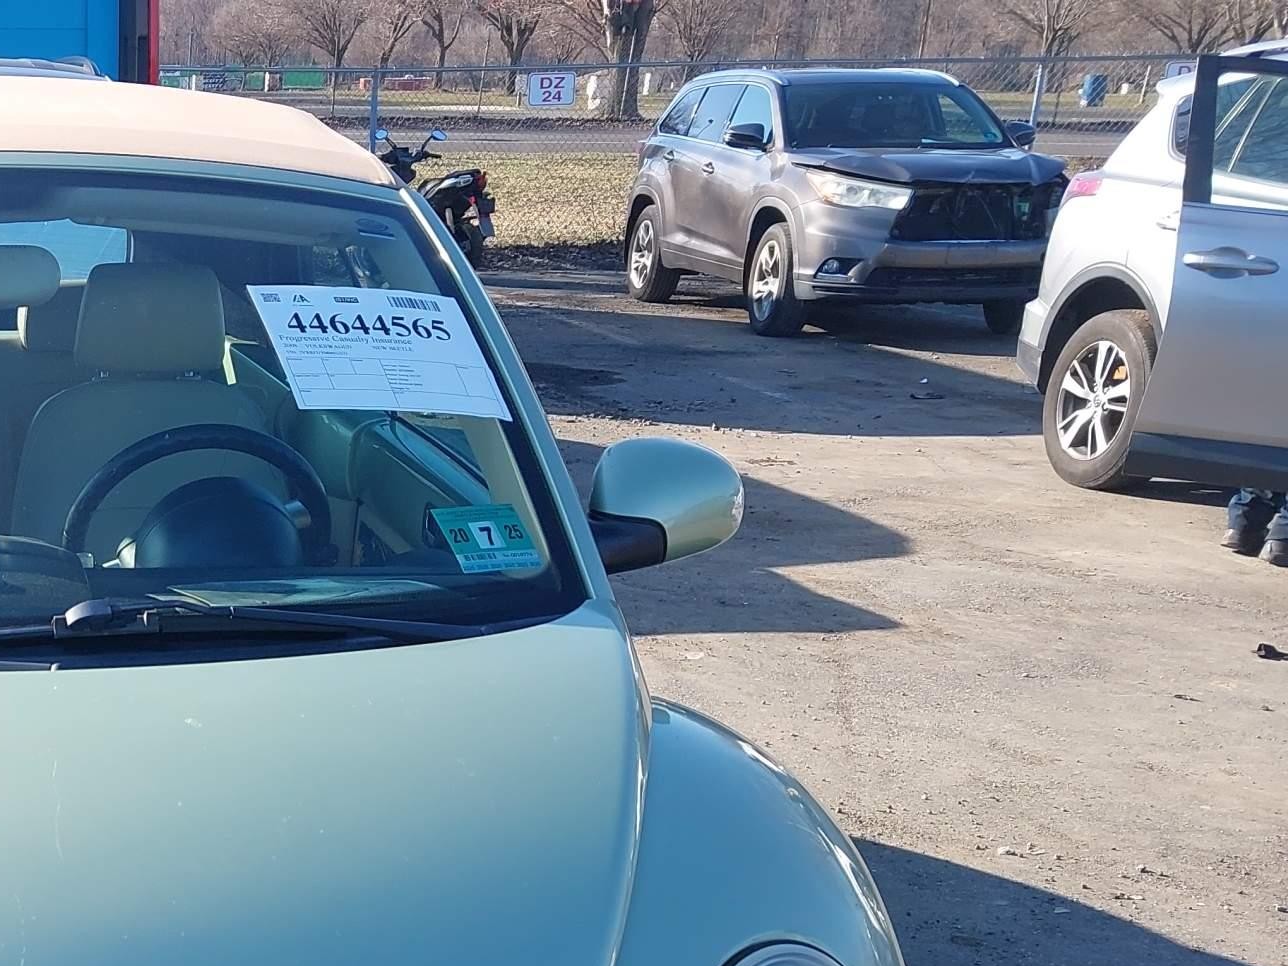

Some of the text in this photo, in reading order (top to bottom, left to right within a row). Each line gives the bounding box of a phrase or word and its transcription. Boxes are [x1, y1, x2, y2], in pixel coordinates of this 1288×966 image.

[540, 77, 565, 89] DZ
[542, 90, 562, 102] 24
[288, 312, 451, 341] 44644565
[279, 334, 412, 345] Progressive Casualty Insurance
[449, 524, 524, 546] 20 7 25
